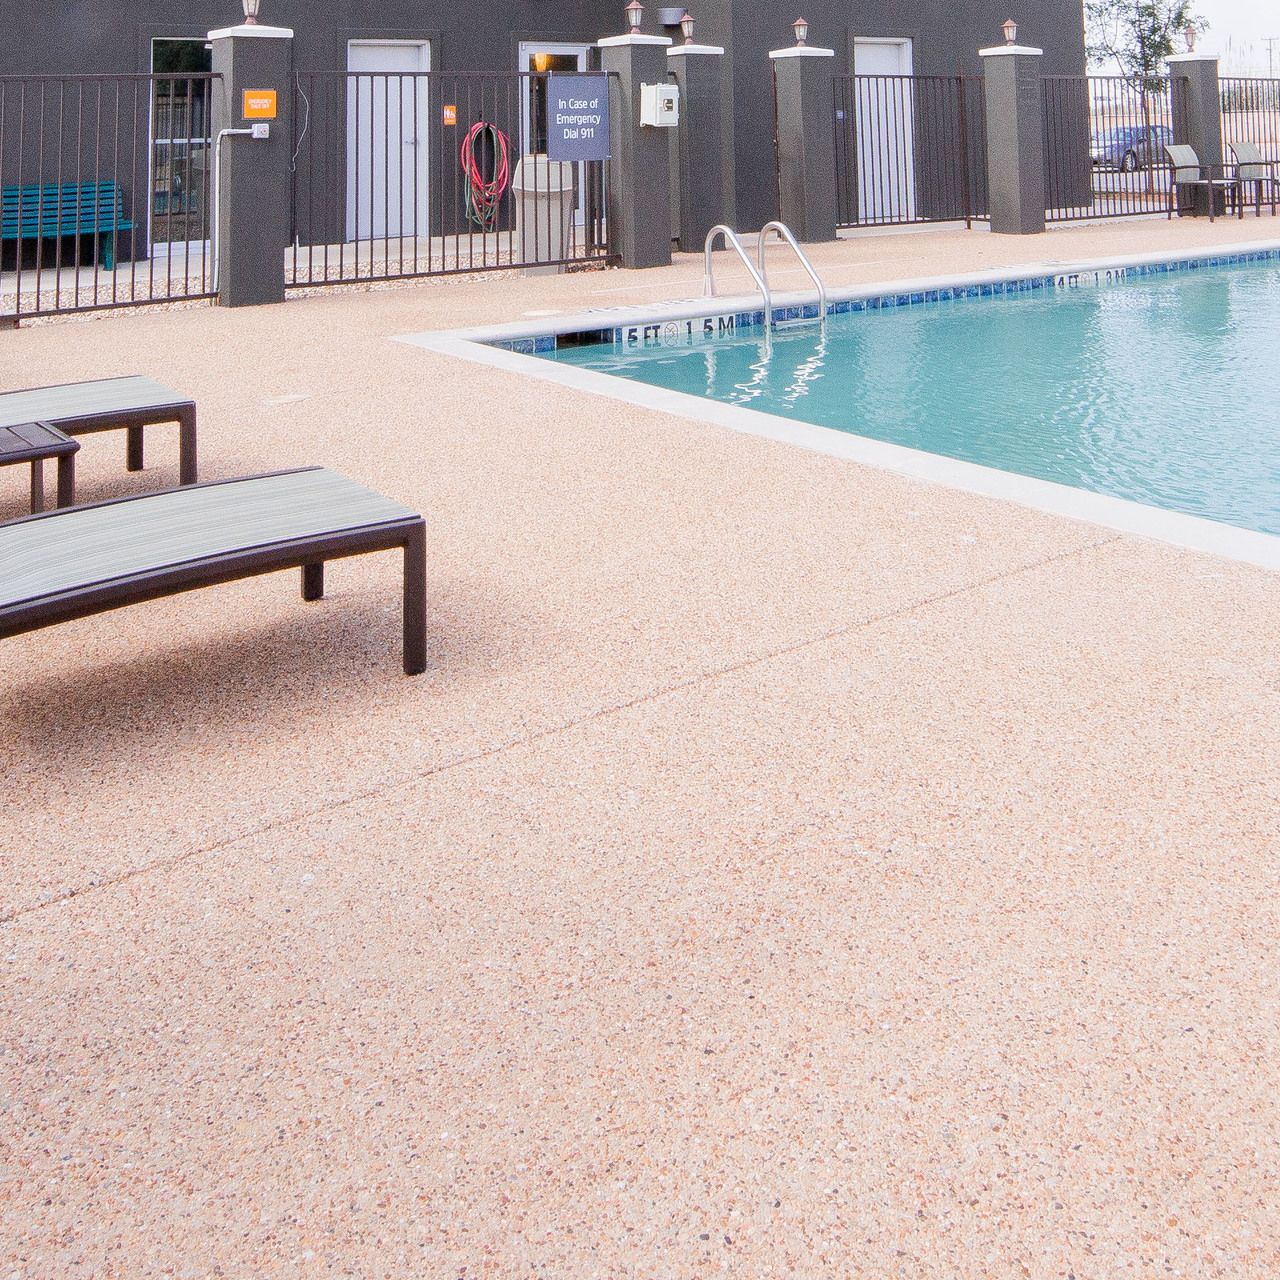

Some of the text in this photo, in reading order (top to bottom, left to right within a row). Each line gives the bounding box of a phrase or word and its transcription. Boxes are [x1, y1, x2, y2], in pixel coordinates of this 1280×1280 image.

[558, 97, 599, 110] In Case of
[556, 113, 601, 126] Emergency
[563, 127, 595, 139] Dial 911
[627, 327, 638, 342] 5
